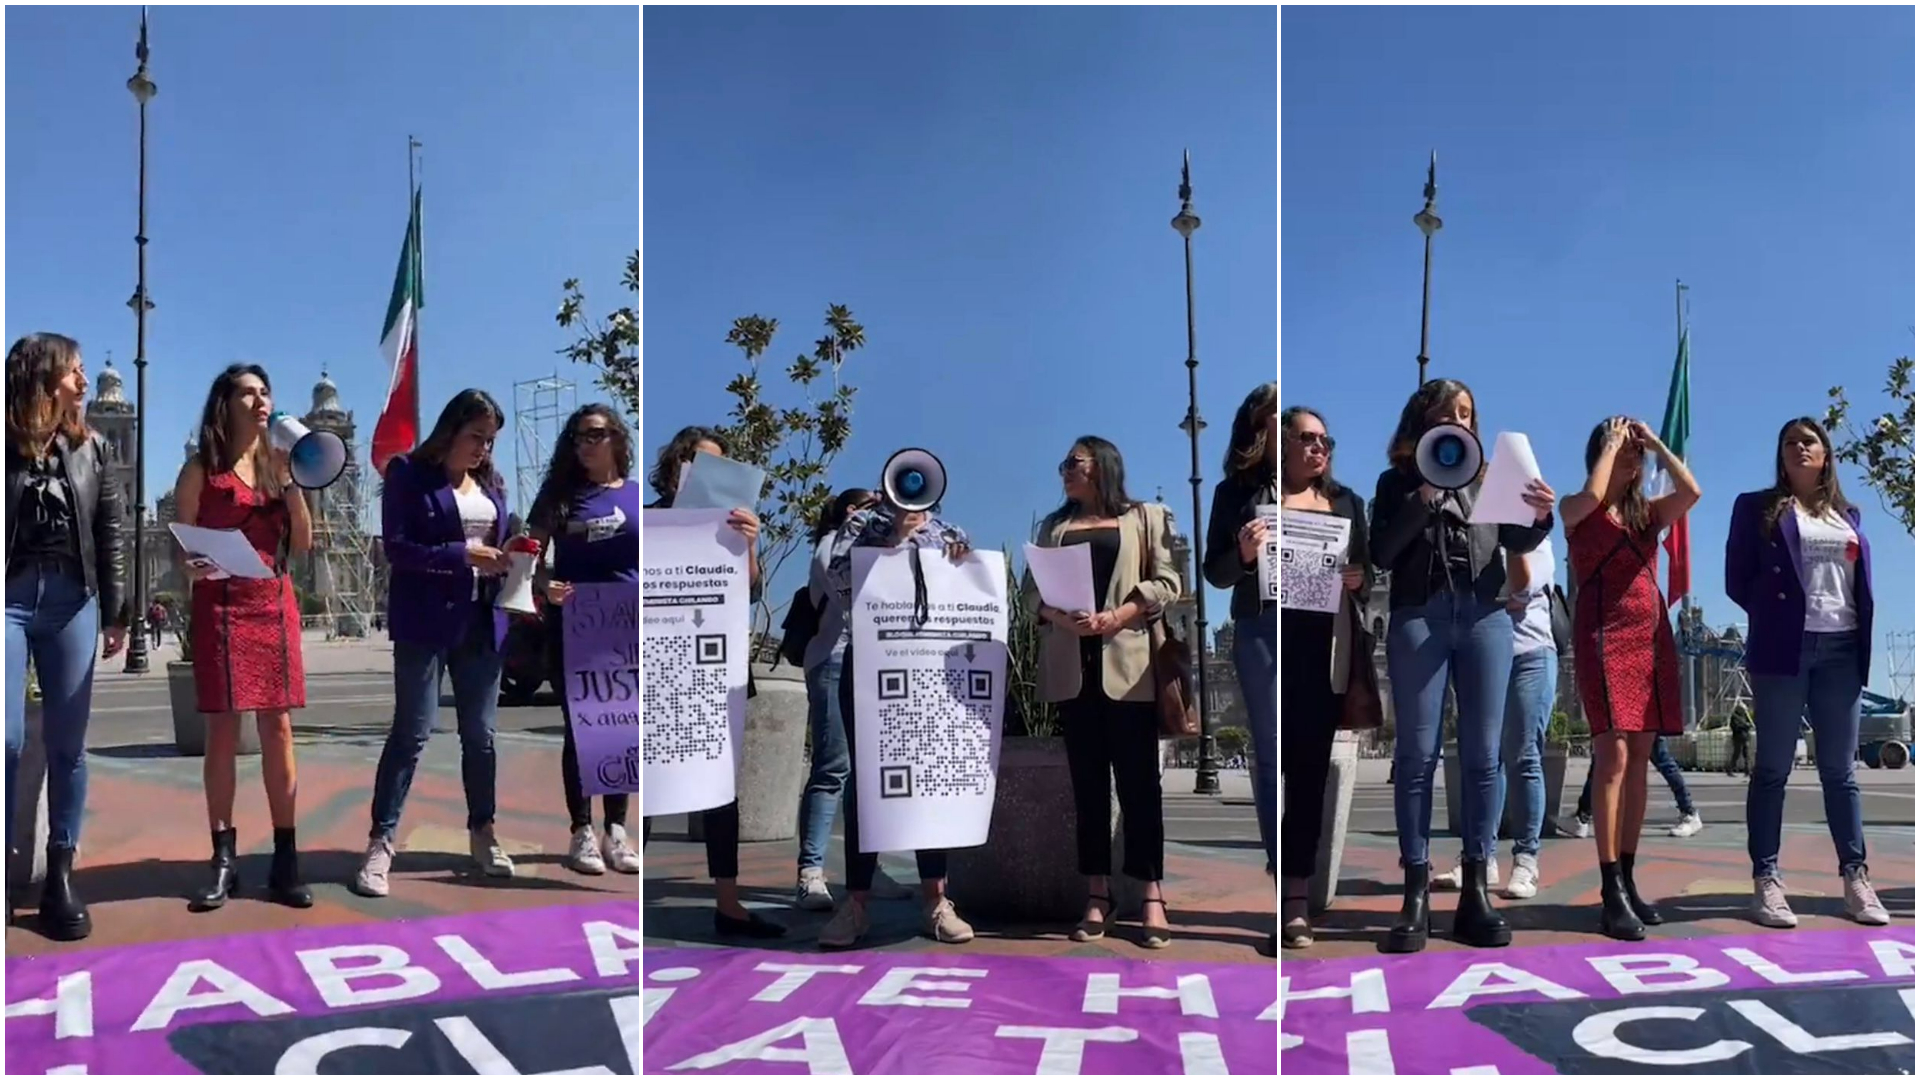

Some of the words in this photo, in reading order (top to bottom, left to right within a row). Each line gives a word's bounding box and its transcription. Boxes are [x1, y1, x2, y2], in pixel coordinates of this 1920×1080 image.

[664, 567, 673, 576] a
[675, 565, 684, 575] ti
[685, 564, 738, 576] Claudia,
[659, 579, 729, 591] respuestas
[865, 602, 879, 612] Te
[938, 603, 946, 612] a
[947, 601, 955, 612] ti
[933, 614, 995, 626] respuestas
[885, 649, 898, 657] Ve
[899, 648, 910, 657] el
